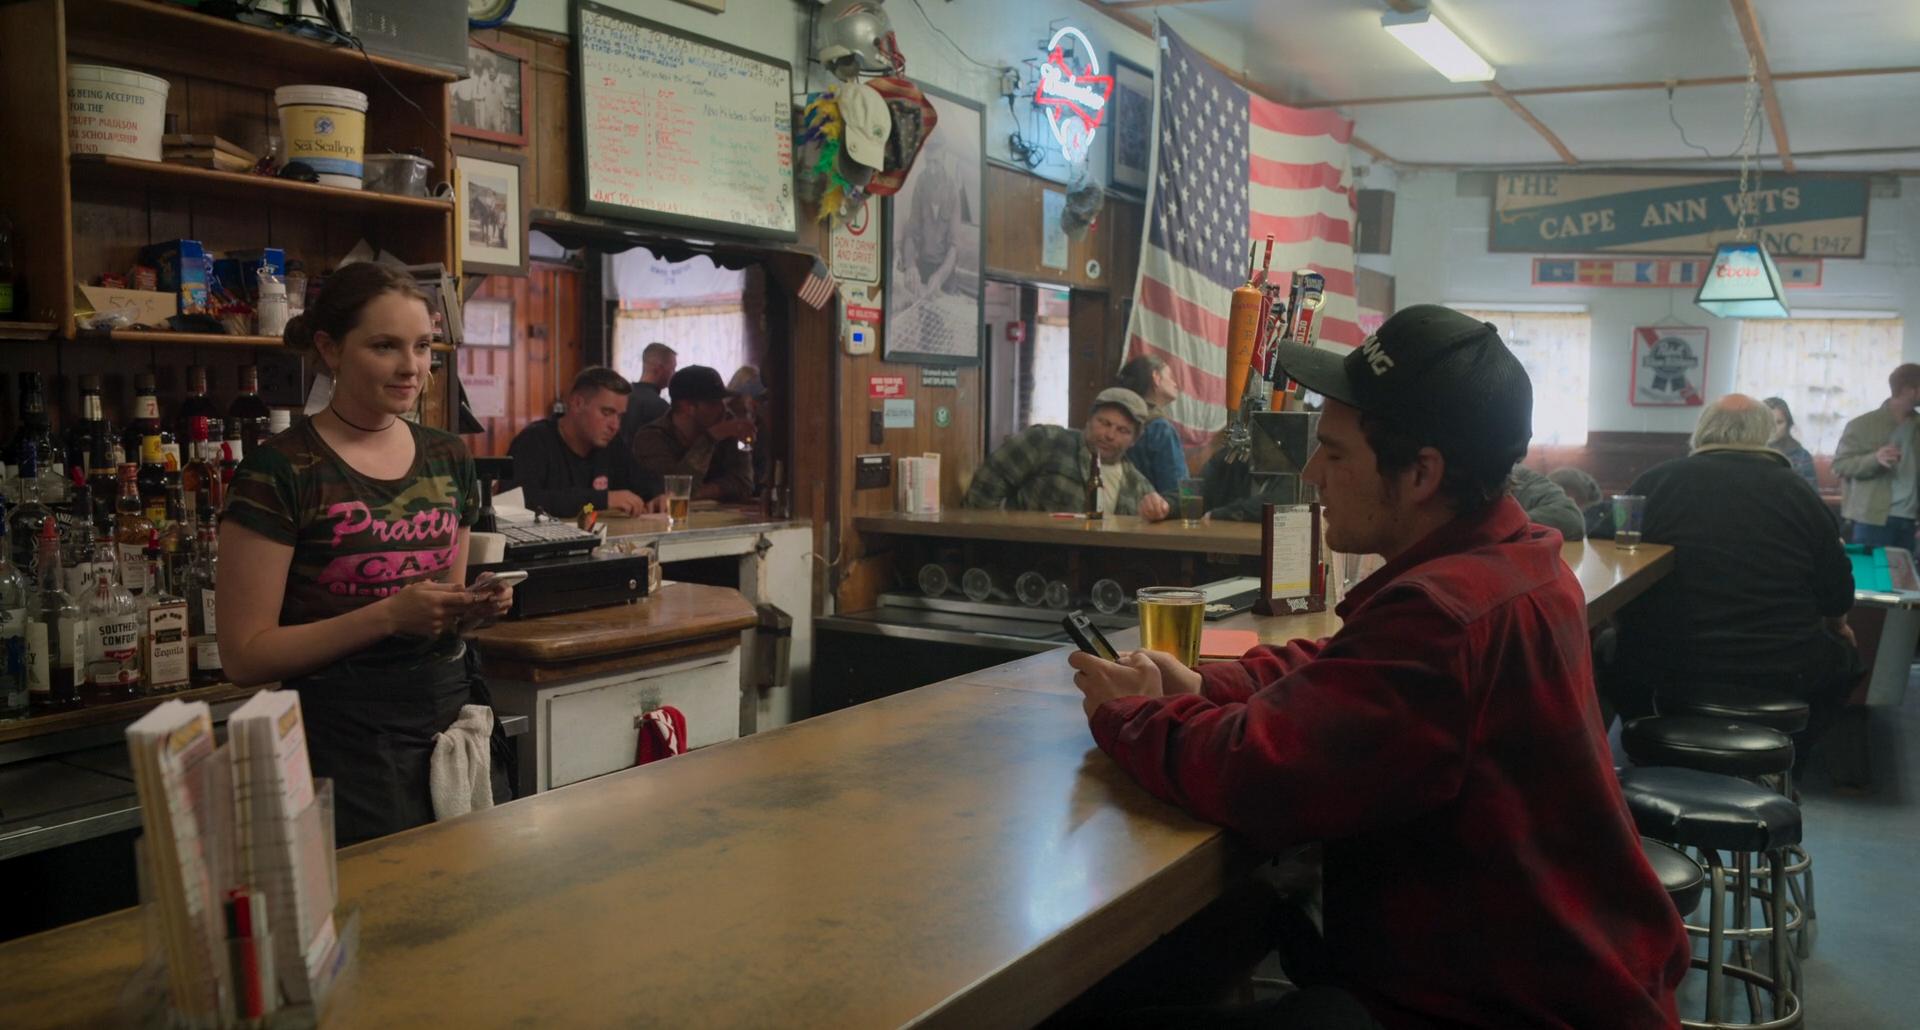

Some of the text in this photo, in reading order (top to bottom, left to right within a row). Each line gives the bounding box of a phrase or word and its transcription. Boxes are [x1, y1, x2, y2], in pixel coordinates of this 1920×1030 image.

[77, 88, 103, 100] BEING
[105, 91, 145, 105] ACCEPTED
[88, 104, 105, 113] THE
[294, 138, 356, 157] Sea Scallops
[1504, 175, 1557, 196] THE
[1538, 186, 1801, 240] CAPE ANN VETS
[1812, 235, 1852, 252] 1947
[98, 622, 137, 636] SOUTHE
[154, 645, 185, 660] Tequila
